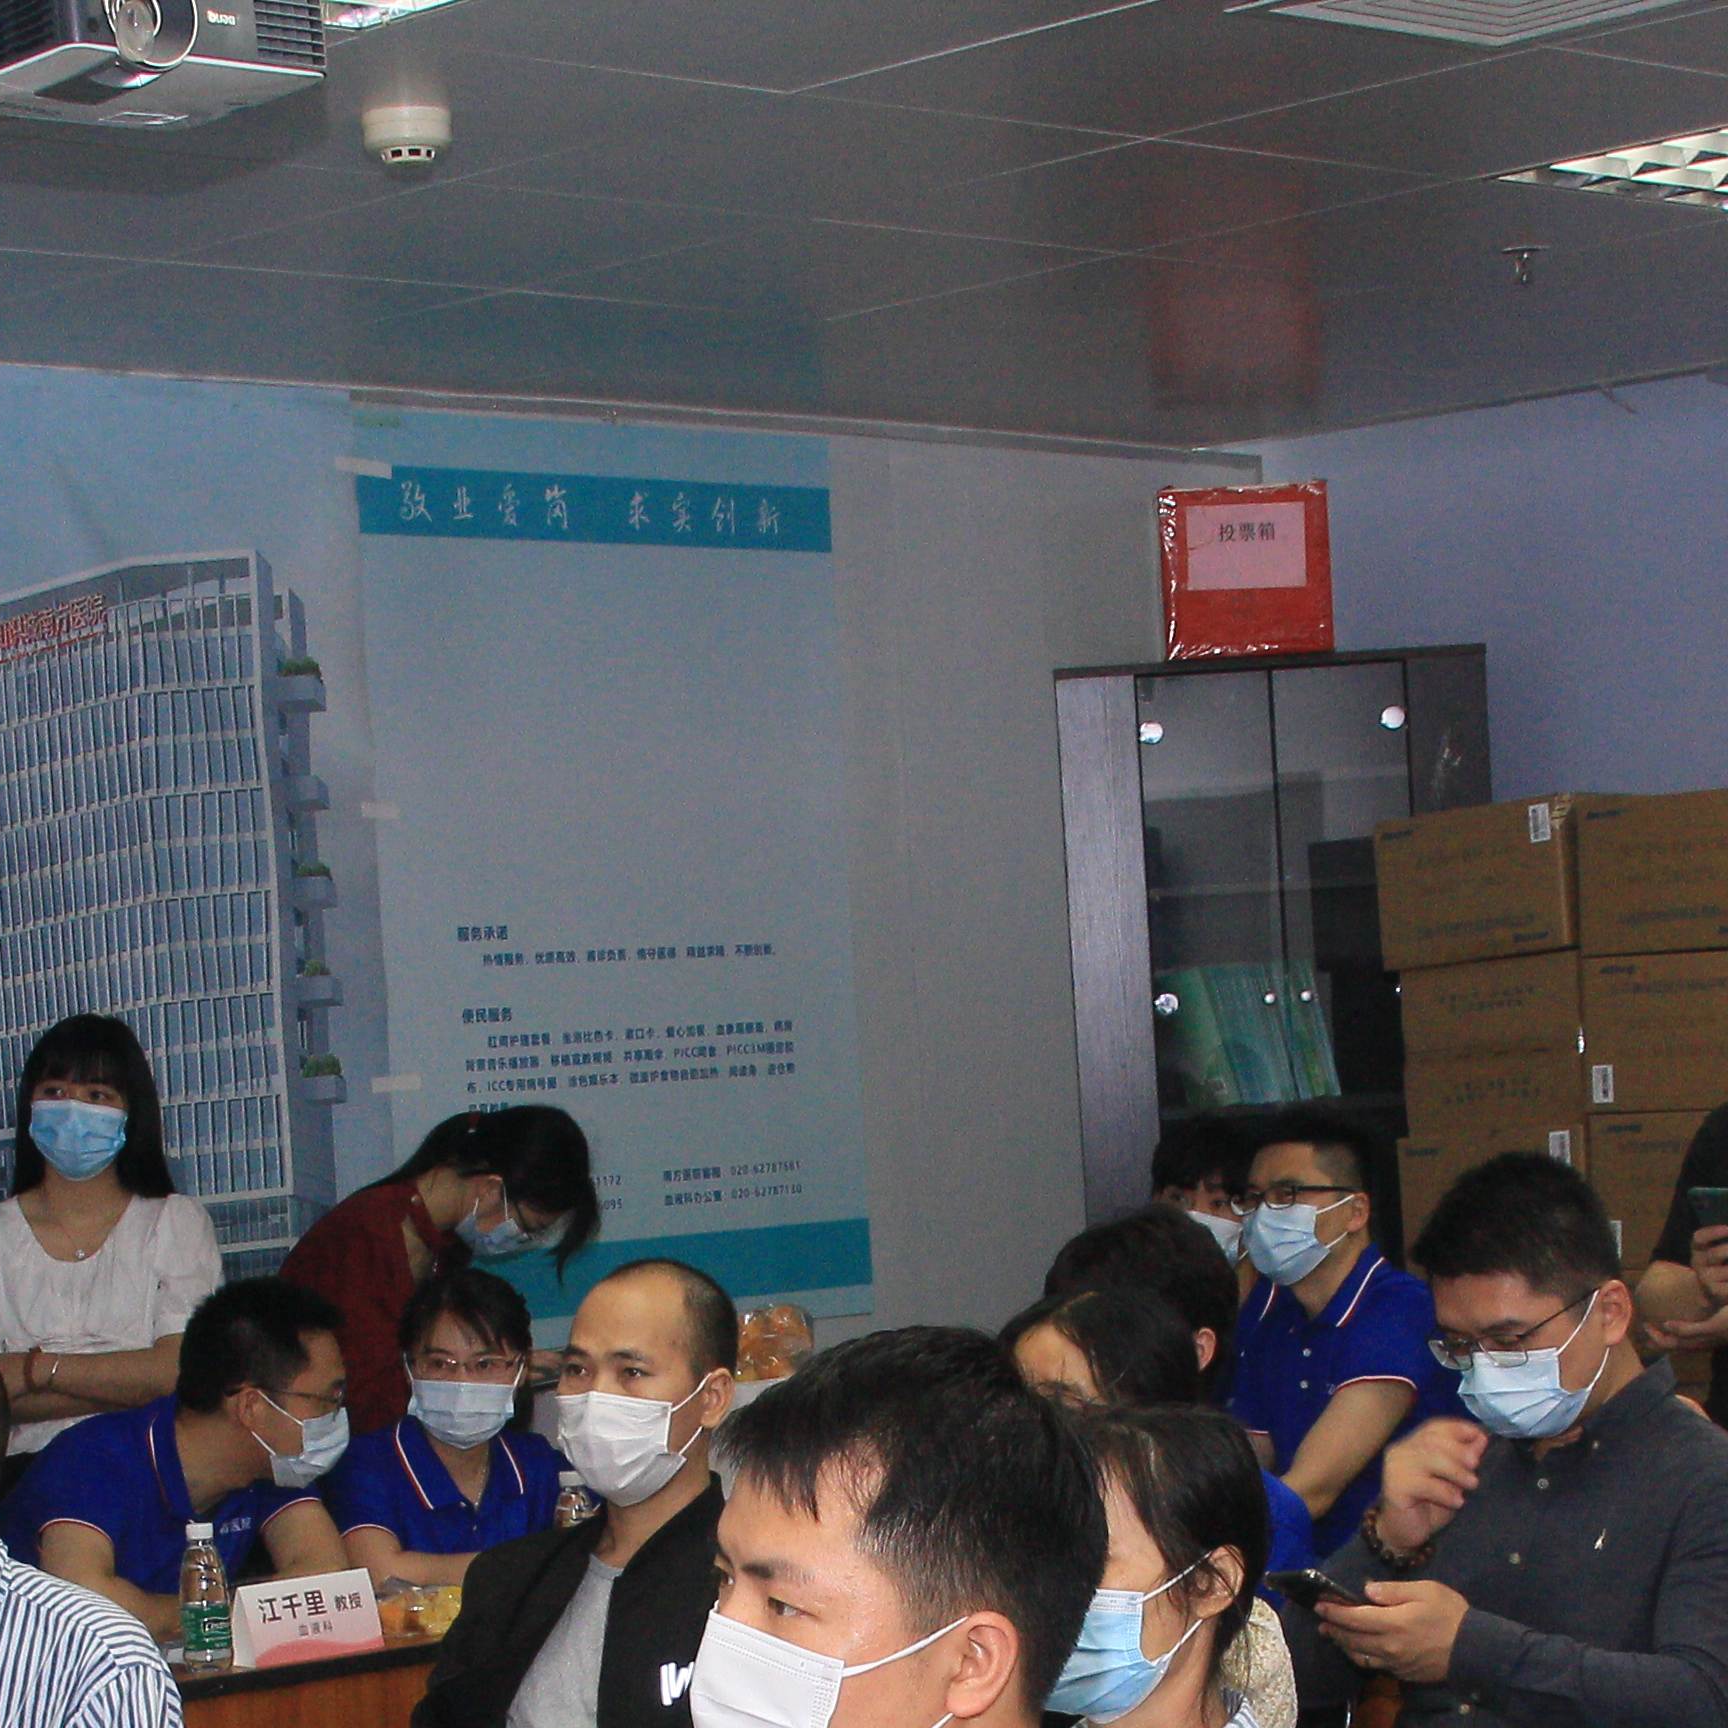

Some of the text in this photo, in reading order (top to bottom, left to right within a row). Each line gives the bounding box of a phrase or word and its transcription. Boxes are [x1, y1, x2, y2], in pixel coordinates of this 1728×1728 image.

[399, 480, 781, 535] 敬业爱岗 求实创新
[1219, 521, 1277, 543] 投票箱
[258, 1590, 363, 1624] 江千里 教授
